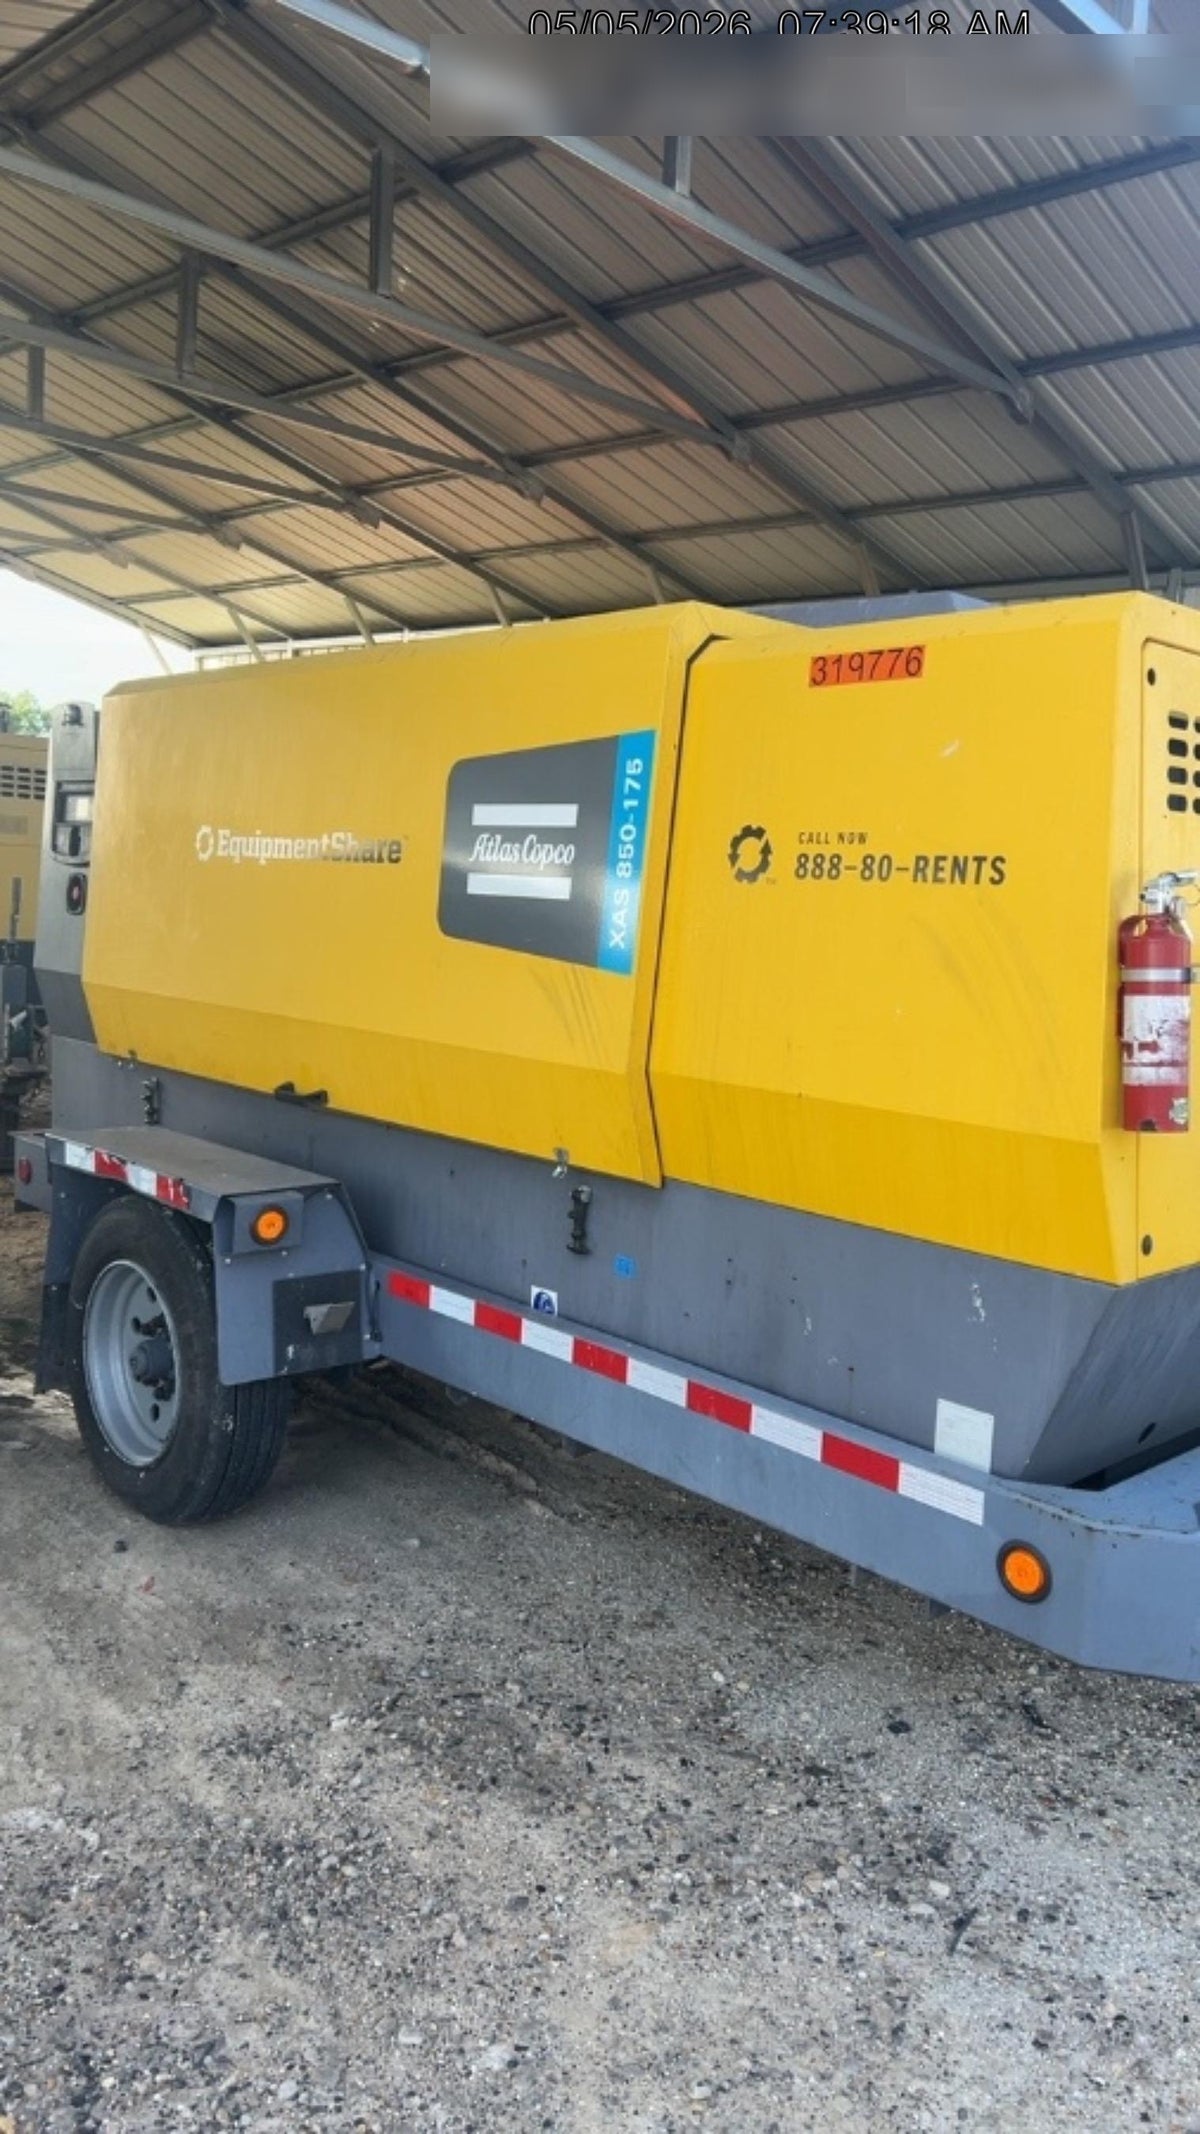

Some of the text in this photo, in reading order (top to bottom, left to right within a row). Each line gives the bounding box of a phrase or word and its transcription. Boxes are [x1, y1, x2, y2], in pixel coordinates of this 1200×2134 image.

[811, 646, 923, 685] 319776
[217, 829, 402, 864] EquipmentShare
[469, 833, 575, 870] Atlas Copco
[610, 758, 643, 948] XAS 850-175
[798, 832, 868, 845] CALL NOW
[795, 853, 1006, 885] 888-80-RENTS
